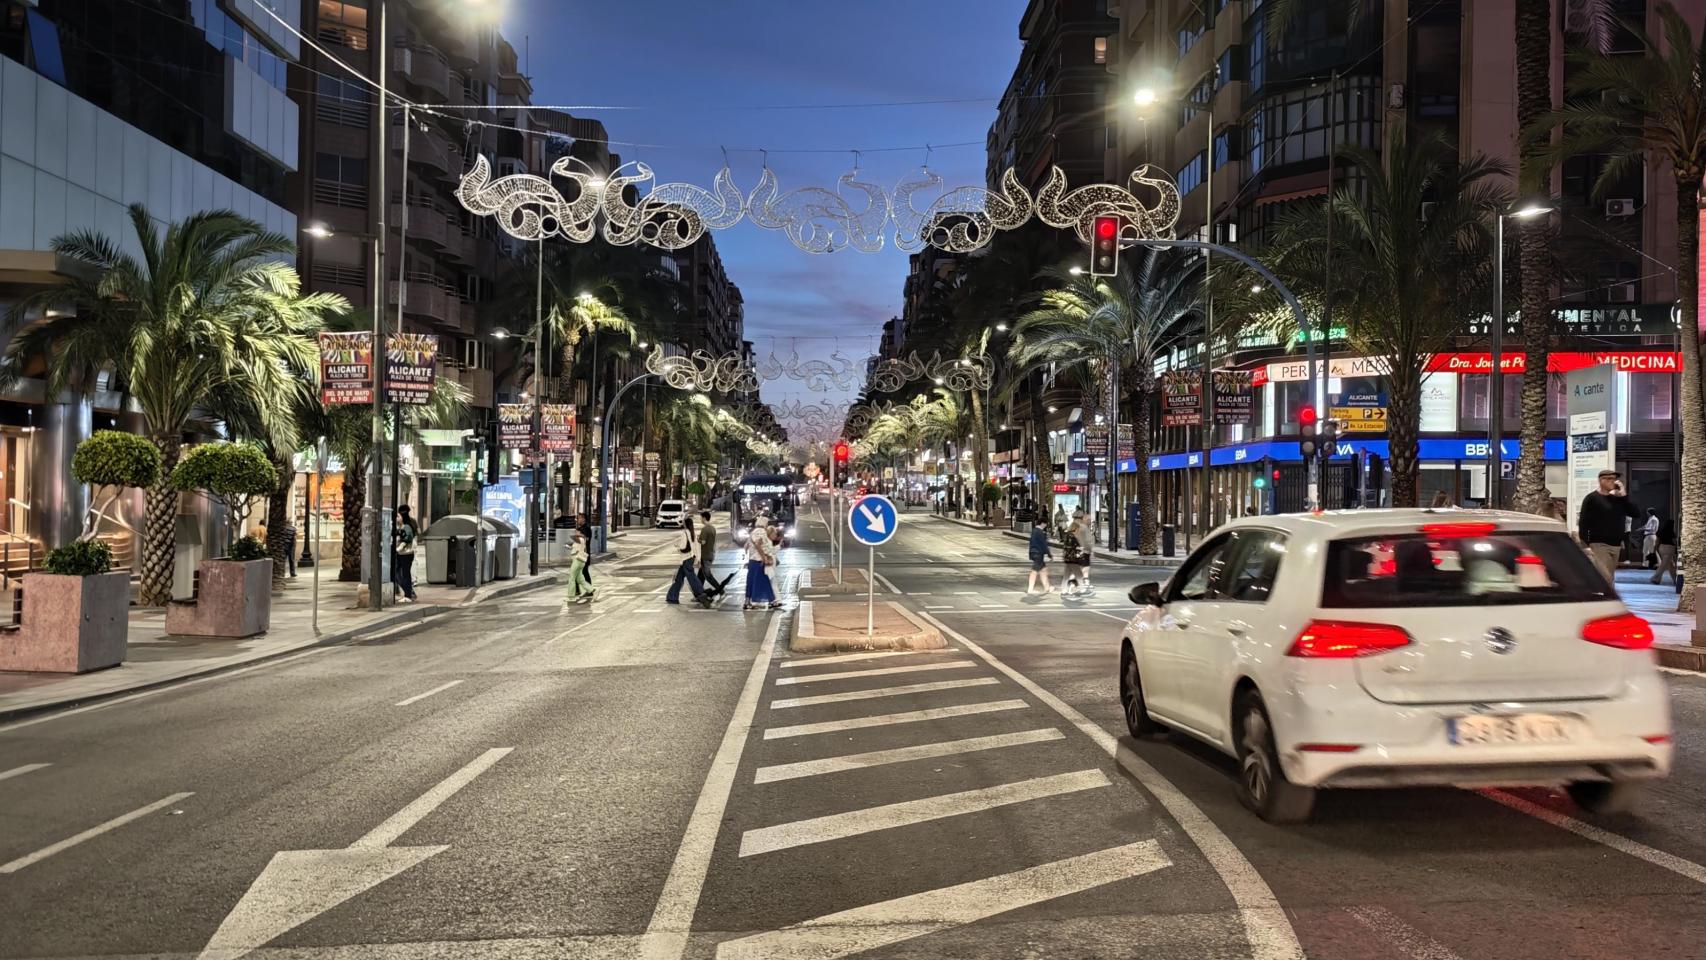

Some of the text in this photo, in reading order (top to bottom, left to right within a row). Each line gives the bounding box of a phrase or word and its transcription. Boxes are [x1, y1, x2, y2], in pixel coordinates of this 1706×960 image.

[1450, 357, 1472, 368] Dra.
[1597, 356, 1676, 368] MEDICINA
[388, 366, 432, 377] ALICANTE
[1282, 364, 1324, 378] PERA
[1168, 395, 1198, 403] ALICANTE
[1465, 444, 1508, 455] BBA
